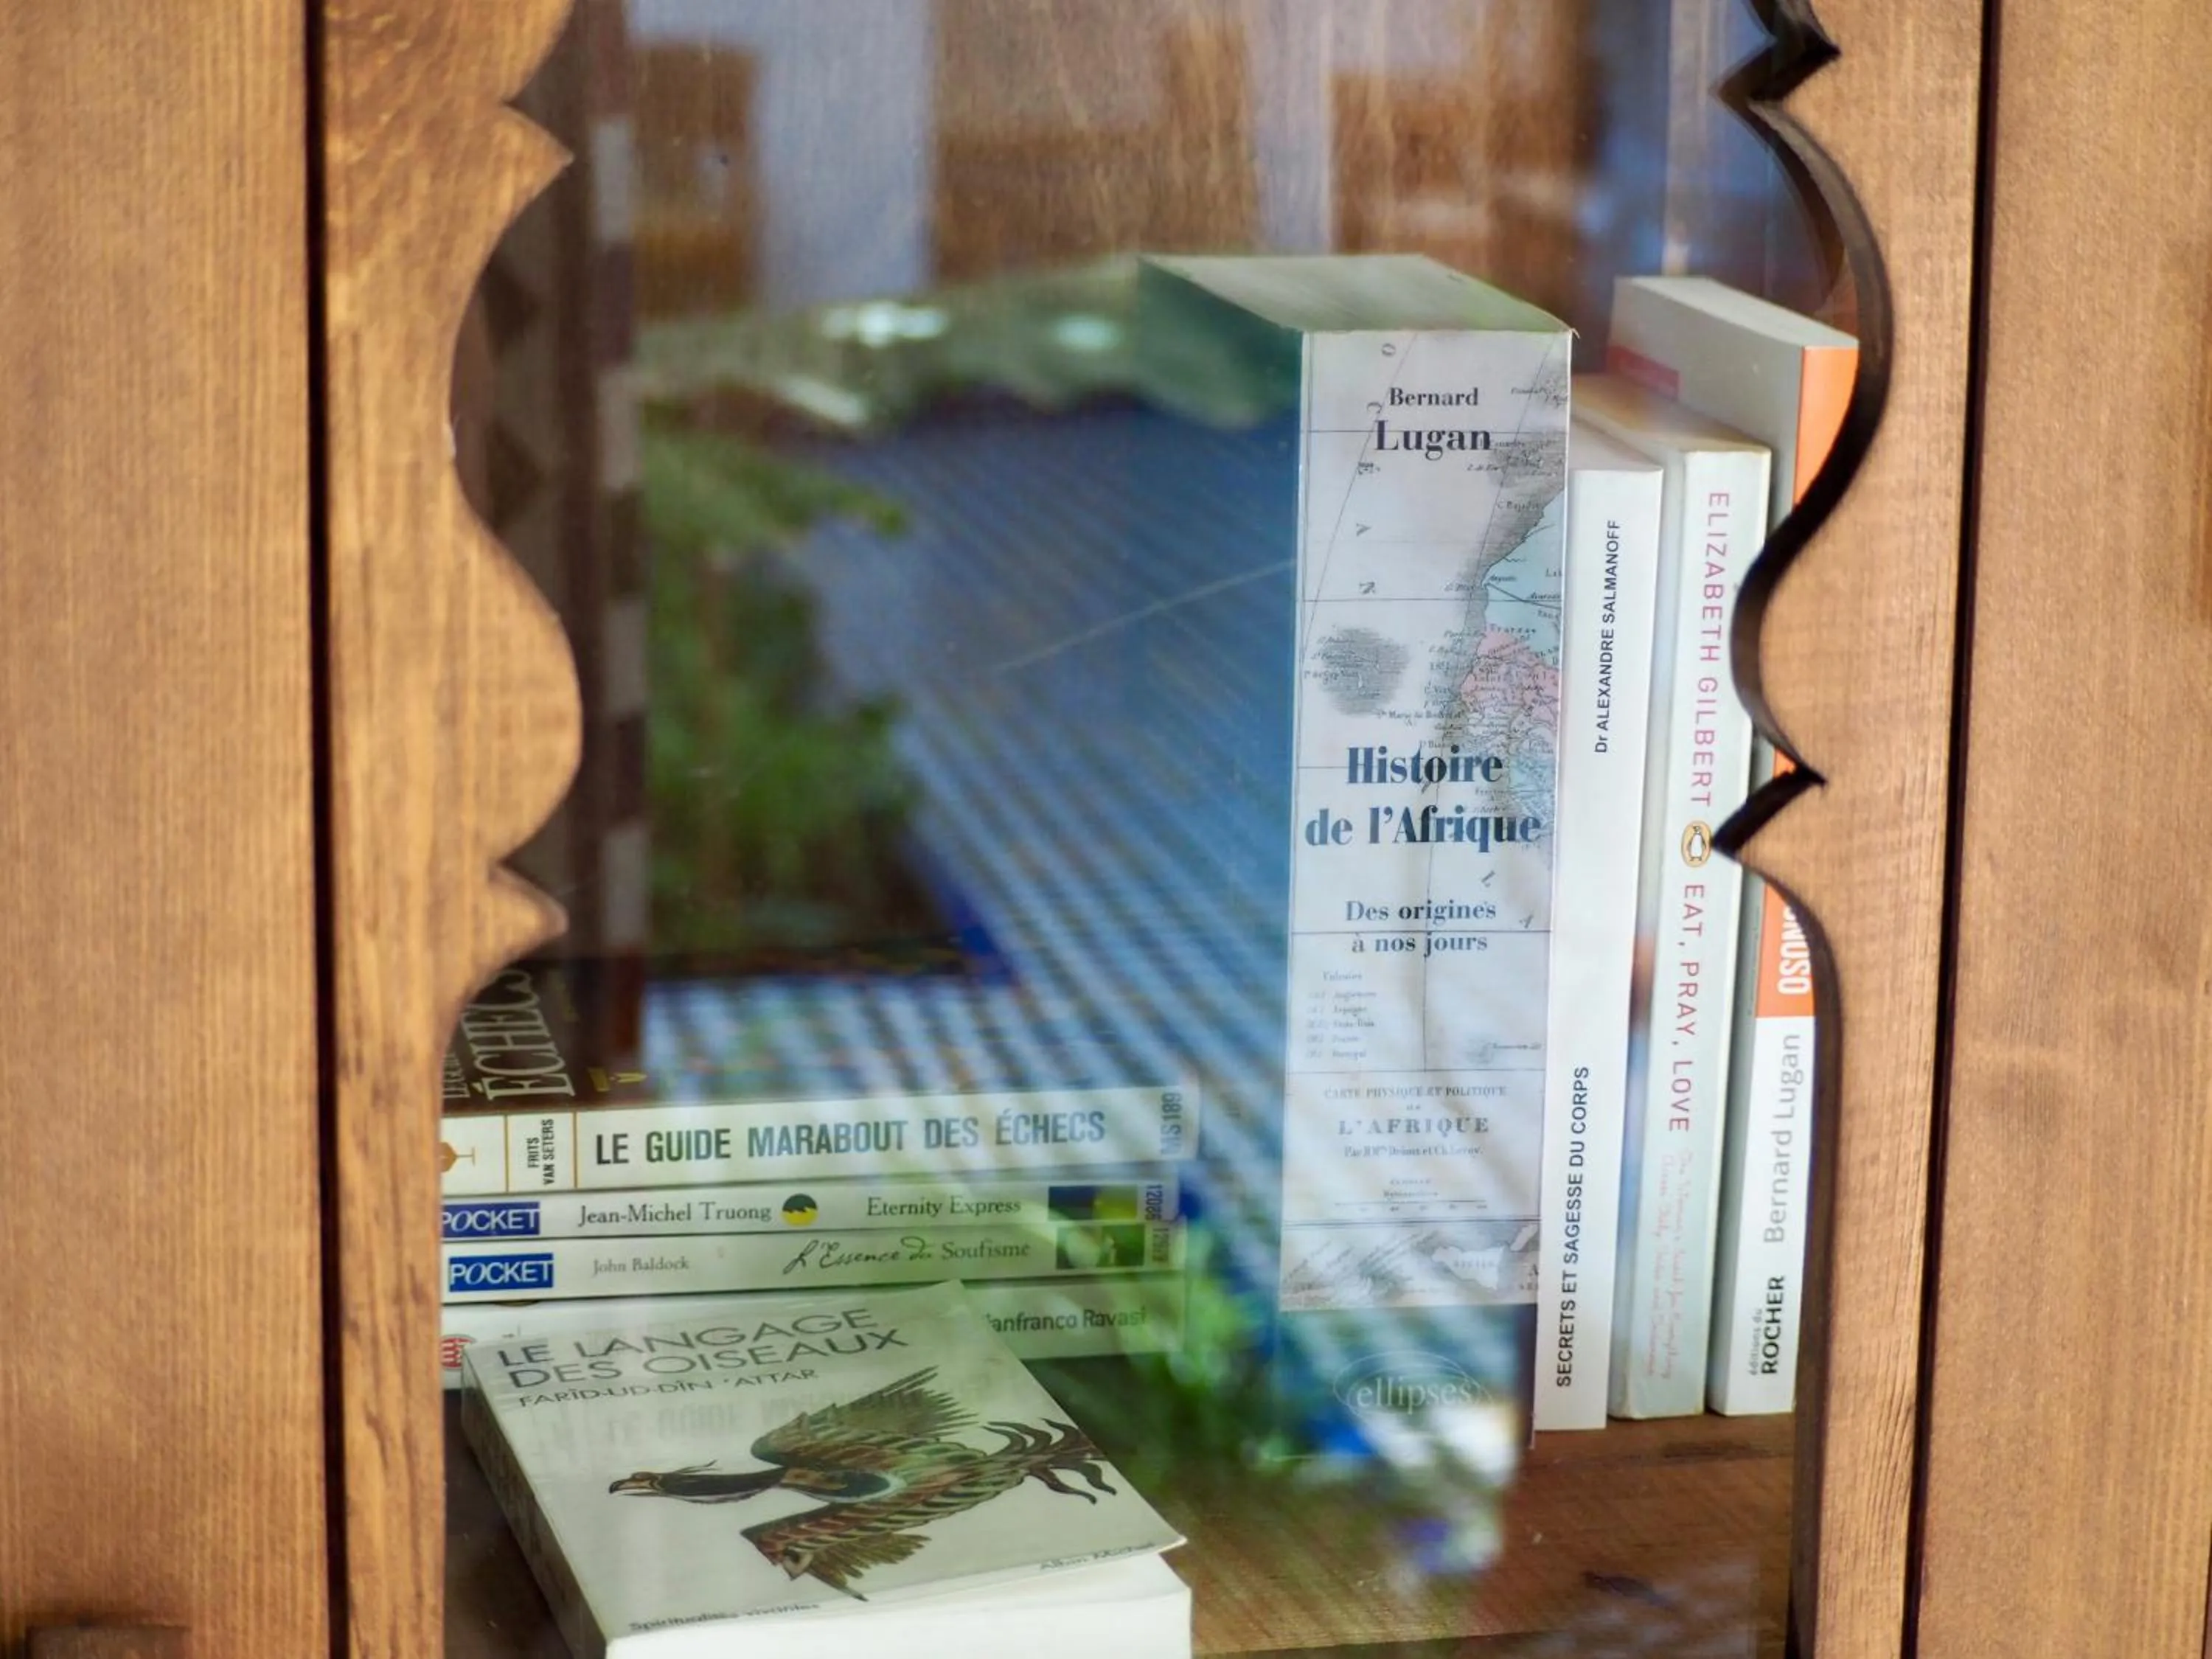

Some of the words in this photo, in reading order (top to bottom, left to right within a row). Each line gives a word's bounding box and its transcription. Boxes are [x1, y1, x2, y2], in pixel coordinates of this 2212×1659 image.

[1389, 387, 1478, 407] Bernard
[1374, 420, 1492, 461] Lugan
[1602, 519, 1622, 624] SALMANOFF
[1699, 493, 1730, 662] ELIZABETH
[1596, 628, 1615, 731] ALEXANDRE
[1594, 735, 1609, 754] Dr
[1691, 676, 1719, 807] GILBERT
[1346, 745, 1503, 785] Histoire
[1304, 808, 1353, 846] de
[1368, 804, 1542, 853] l'Afrique
[1346, 900, 1389, 922] Des
[1398, 899, 1497, 925] origines
[1351, 932, 1365, 953] à
[1374, 936, 1416, 953] nos
[1423, 931, 1488, 958] jours
[1445, 1085, 1507, 1099] POLITIQUE
[1772, 1034, 1804, 1119] Lugan
[1161, 1092, 1183, 1122] 189
[1571, 1066, 1590, 1135] CORPS
[1669, 1060, 1694, 1133] LOVE
[527, 1137, 540, 1168] FRITS
[542, 1119, 554, 1161] SETERS
[596, 1133, 630, 1165] LE
[645, 1128, 731, 1163] GUIDE
[748, 1119, 908, 1158] MARABOUT
[925, 1117, 979, 1149] DES
[995, 1108, 1105, 1146] ÉCHECS
[1568, 1141, 1585, 1166] DU
[543, 1166, 555, 1185] VAN
[1764, 1130, 1794, 1243] Bernard
[442, 1208, 541, 1231] POCKET
[577, 1203, 692, 1228] Jean-Michel
[698, 1201, 772, 1222] Truong
[866, 1196, 943, 1217] Eternity
[949, 1195, 1022, 1216] Express
[1564, 1174, 1584, 1265] SAGESSE
[592, 1258, 627, 1278] John
[632, 1256, 690, 1272] Baldock
[942, 1239, 1031, 1261] Soufisme
[450, 1259, 554, 1286] POCKET
[1562, 1270, 1578, 1293] ET
[986, 1310, 1078, 1332] anfranco
[1082, 1307, 1147, 1327] Ravasi
[1751, 1308, 1763, 1324] du
[1761, 1275, 1785, 1374] ROCHER
[498, 1343, 554, 1367] LE
[574, 1308, 879, 1358] LANGAGE
[1557, 1299, 1576, 1387] SECRETS
[1748, 1326, 1763, 1377] éditions
[509, 1360, 623, 1388] DES
[643, 1328, 909, 1374] OISEAUX
[1357, 1377, 1472, 1415] ellipses
